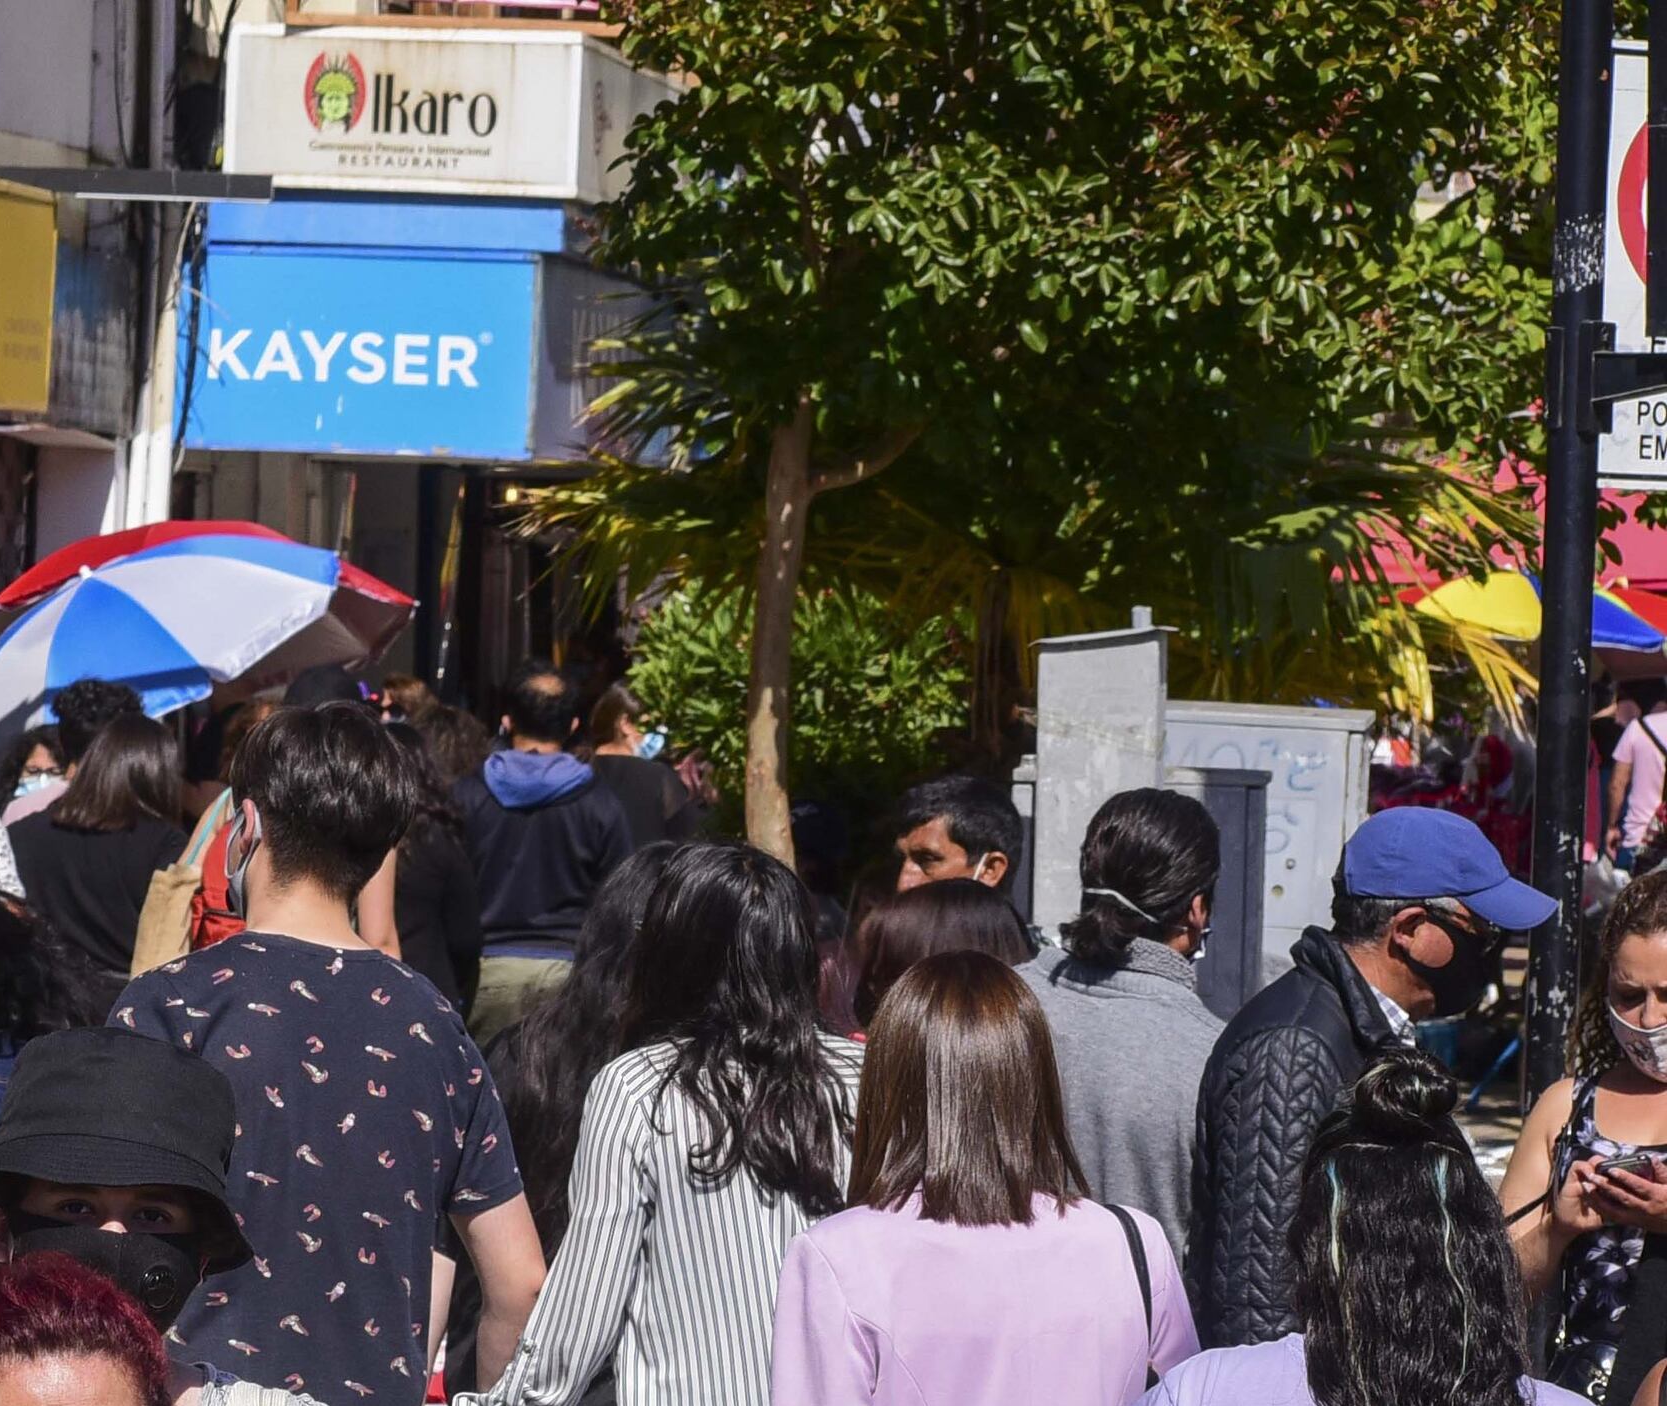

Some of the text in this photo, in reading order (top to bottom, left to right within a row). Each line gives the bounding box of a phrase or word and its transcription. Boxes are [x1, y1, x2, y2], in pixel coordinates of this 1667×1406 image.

[372, 73, 498, 137] Ikaro
[337, 154, 461, 168] RESTAURANT
[207, 328, 480, 387] KAYSER
